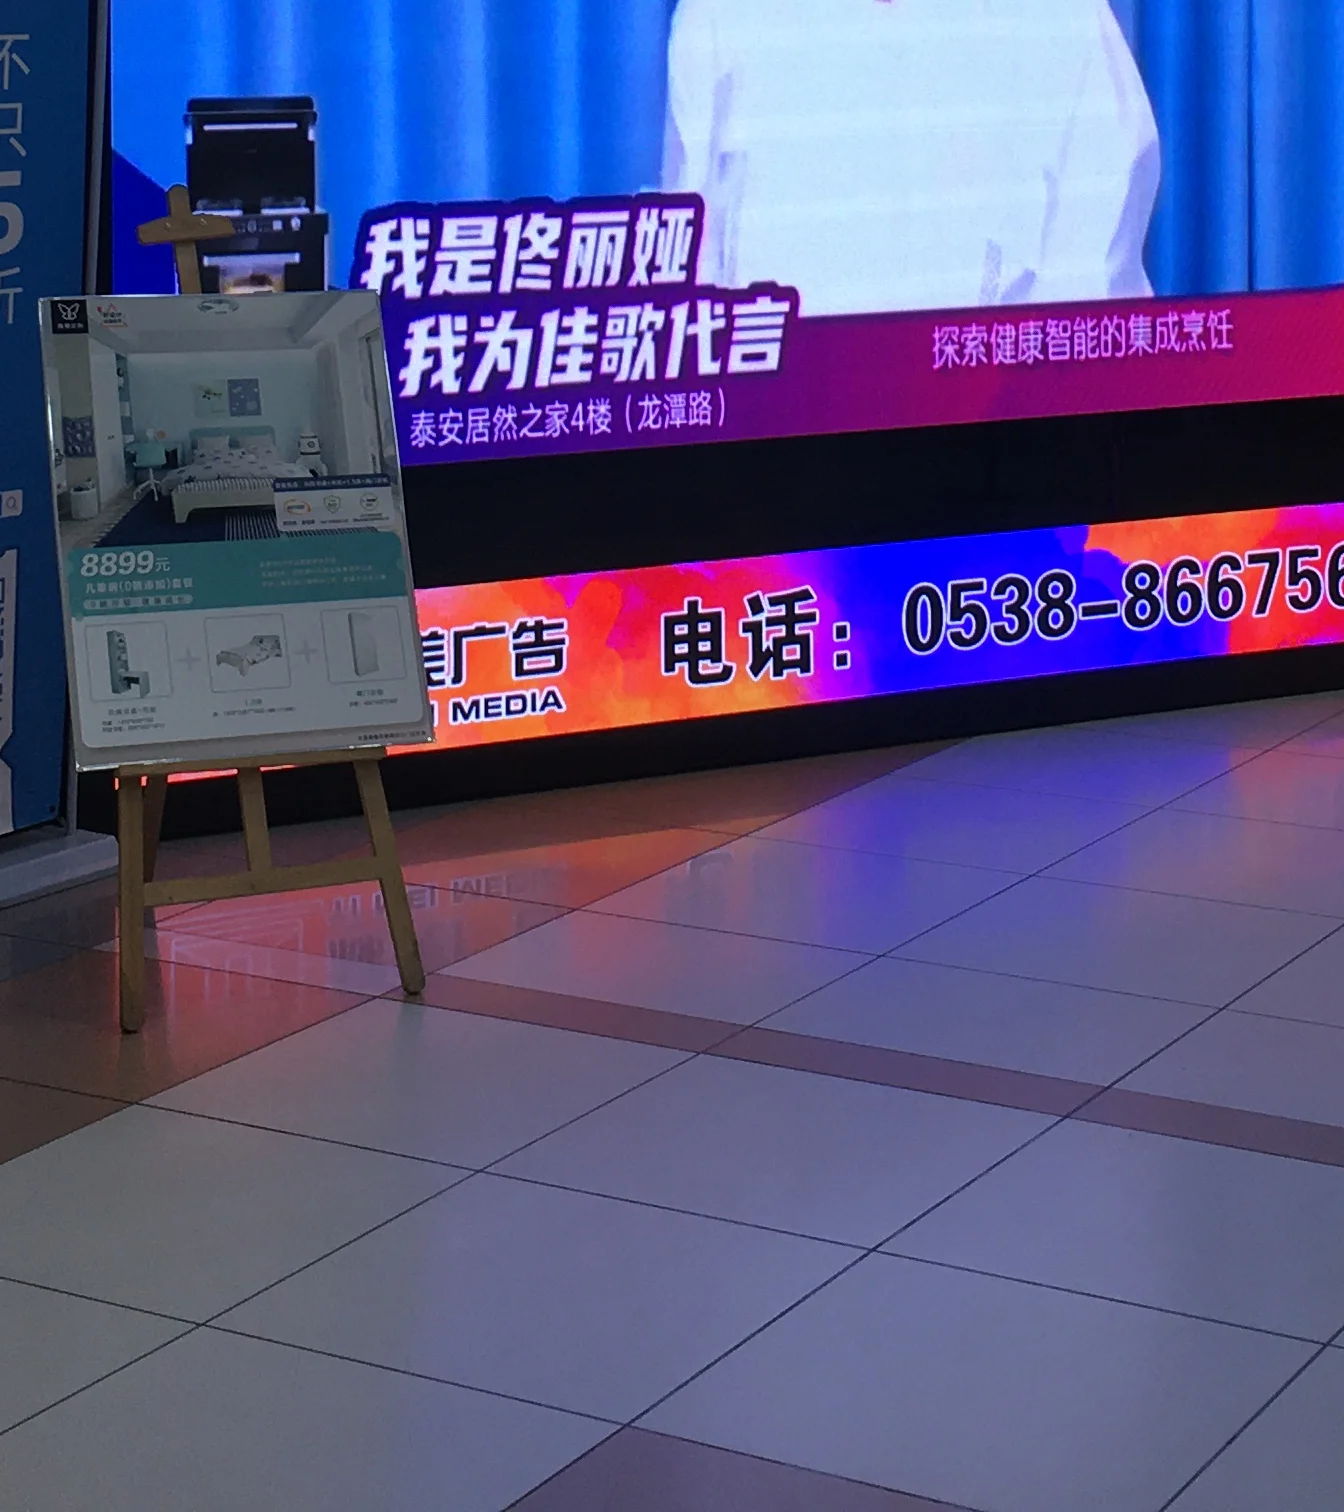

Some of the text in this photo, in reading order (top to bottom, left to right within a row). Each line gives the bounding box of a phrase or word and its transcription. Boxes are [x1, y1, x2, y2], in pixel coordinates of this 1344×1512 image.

[360, 205, 696, 294] 我是佟丽娅
[398, 295, 787, 398] 我为佳歌代言
[930, 308, 1234, 371] 探索健康智能的集成烹饪
[452, 689, 563, 723] MEDIA
